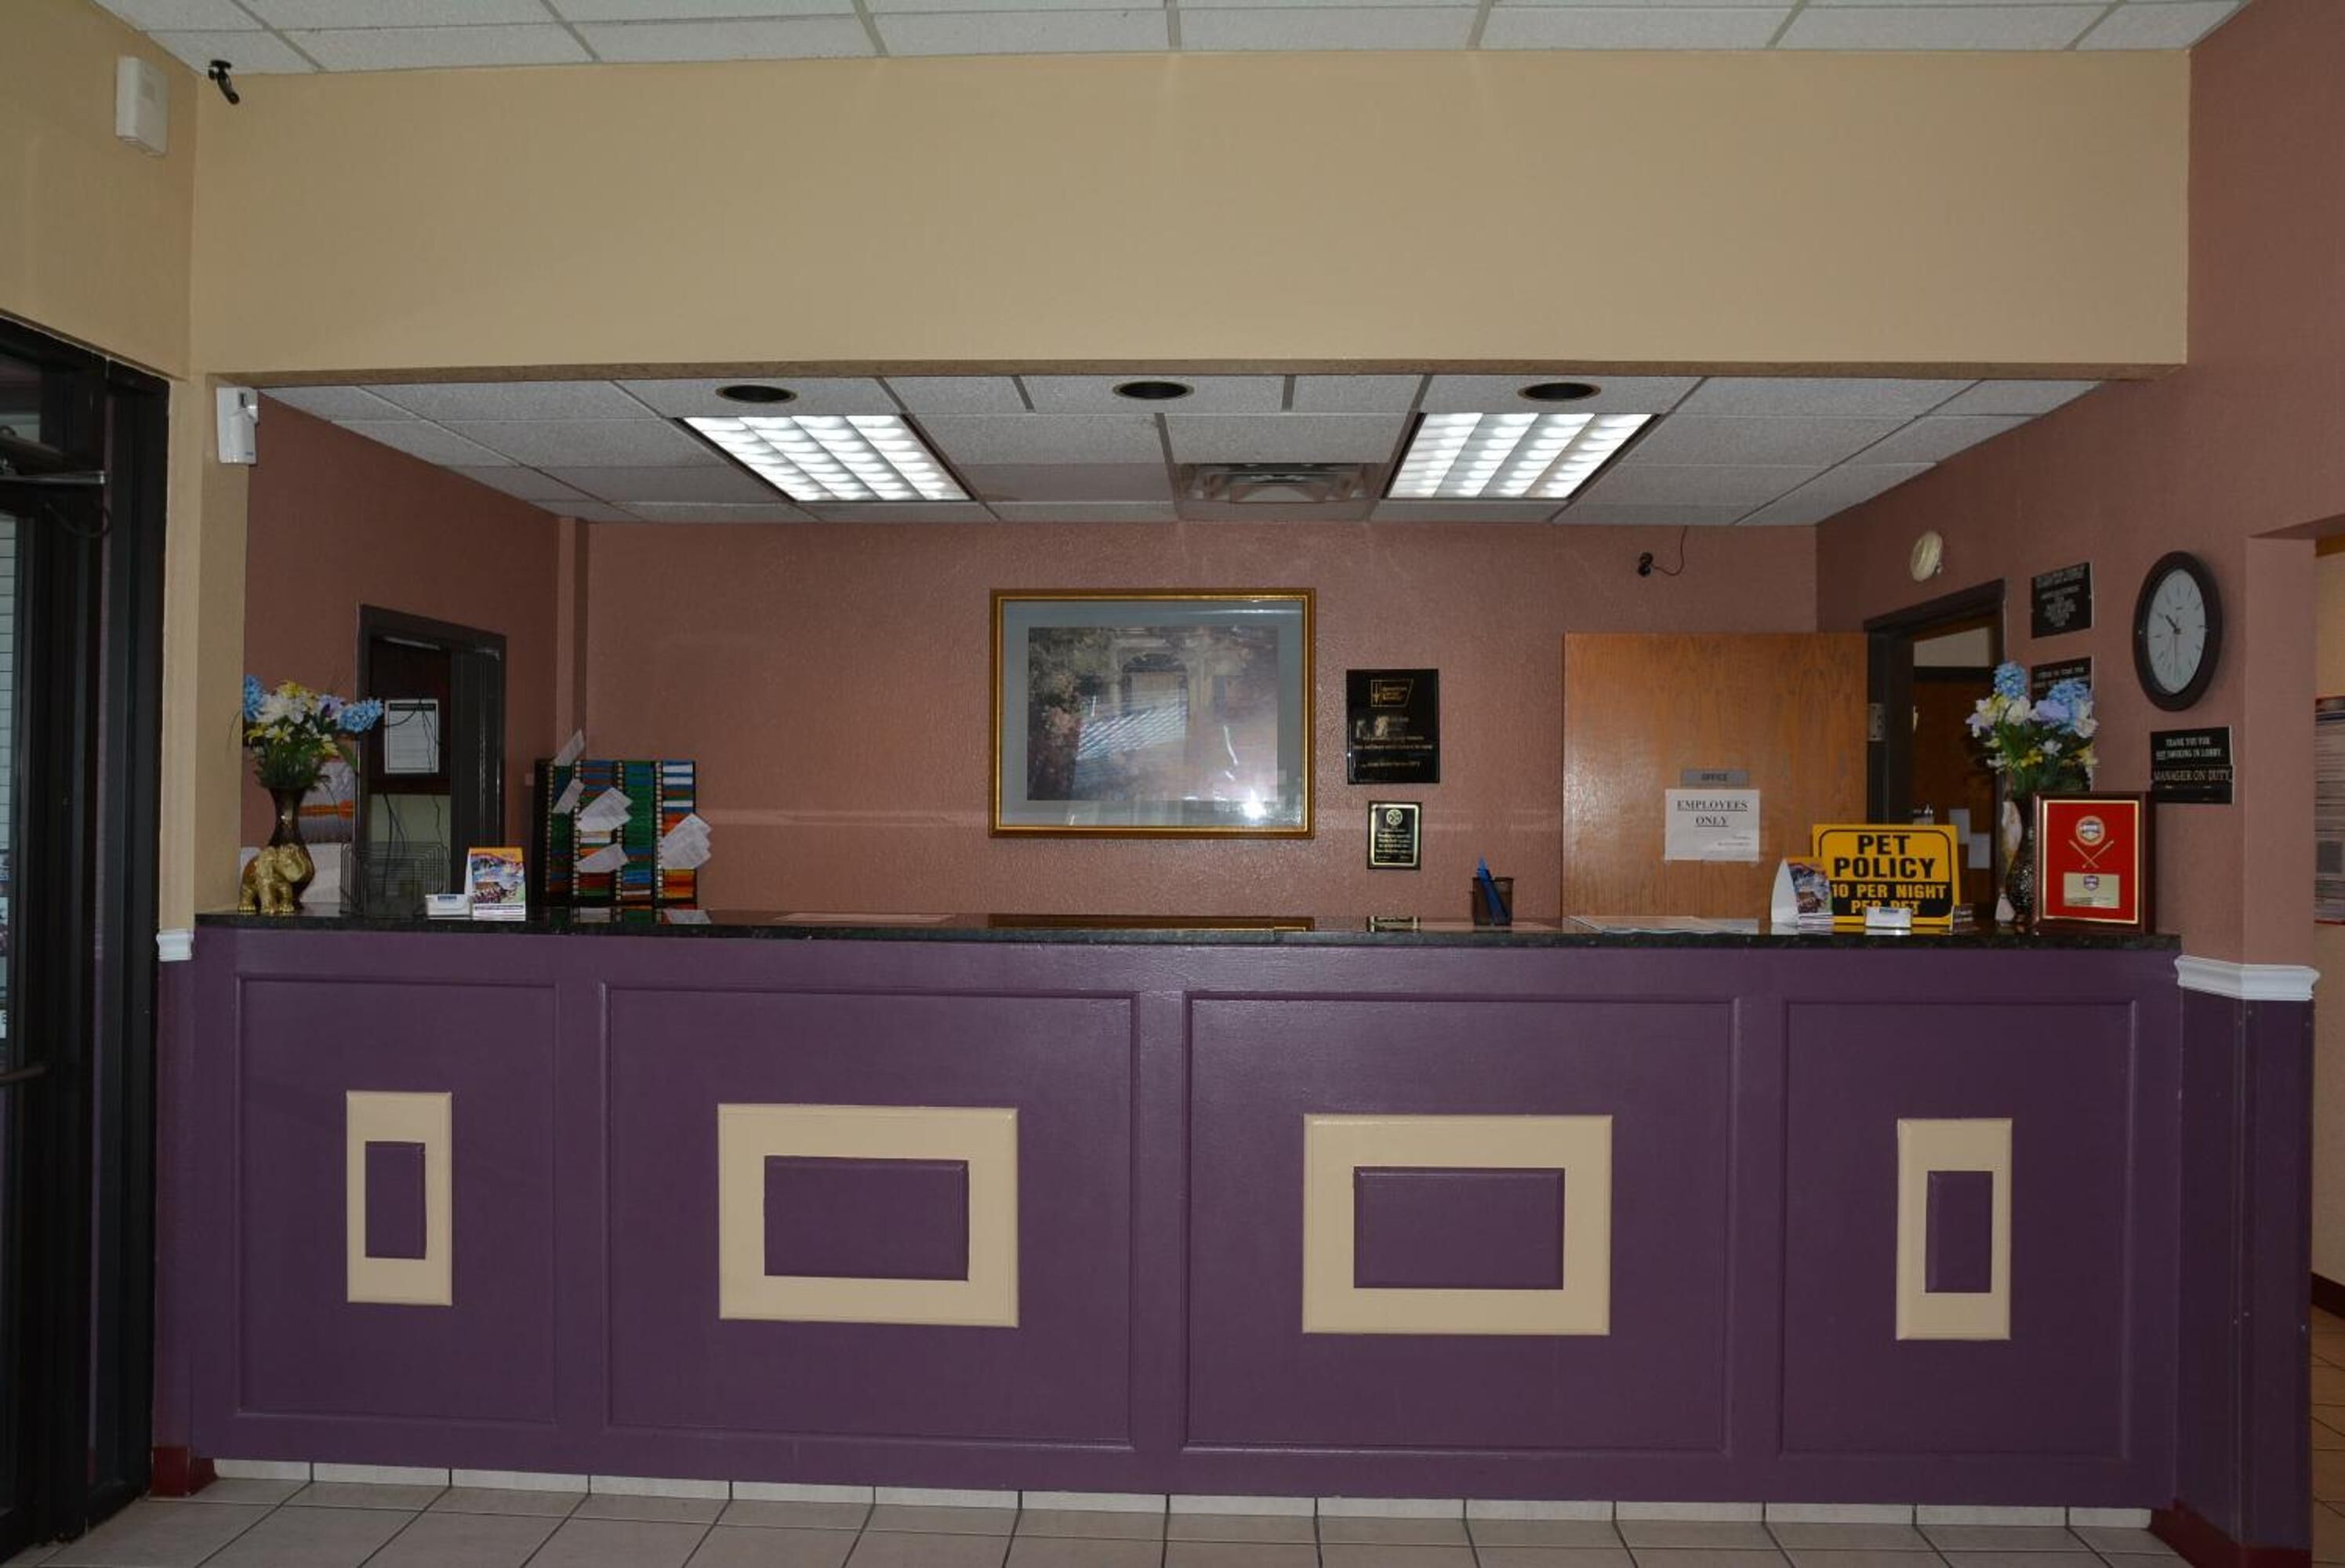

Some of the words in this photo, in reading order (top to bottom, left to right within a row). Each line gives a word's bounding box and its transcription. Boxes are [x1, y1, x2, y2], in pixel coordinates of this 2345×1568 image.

[2154, 770, 2192, 781] MANAGER
[2193, 770, 2205, 780] ON
[2208, 769, 2230, 781] DUTY
[1676, 800, 1748, 810] EMPLOYEES
[1695, 815, 1729, 826] ONLY
[1857, 835, 1911, 855] PET
[1834, 858, 1936, 879] POLICY
[1831, 884, 1849, 898] 10
[1857, 884, 1888, 898] PER
[1896, 884, 1948, 899] NIGHT
